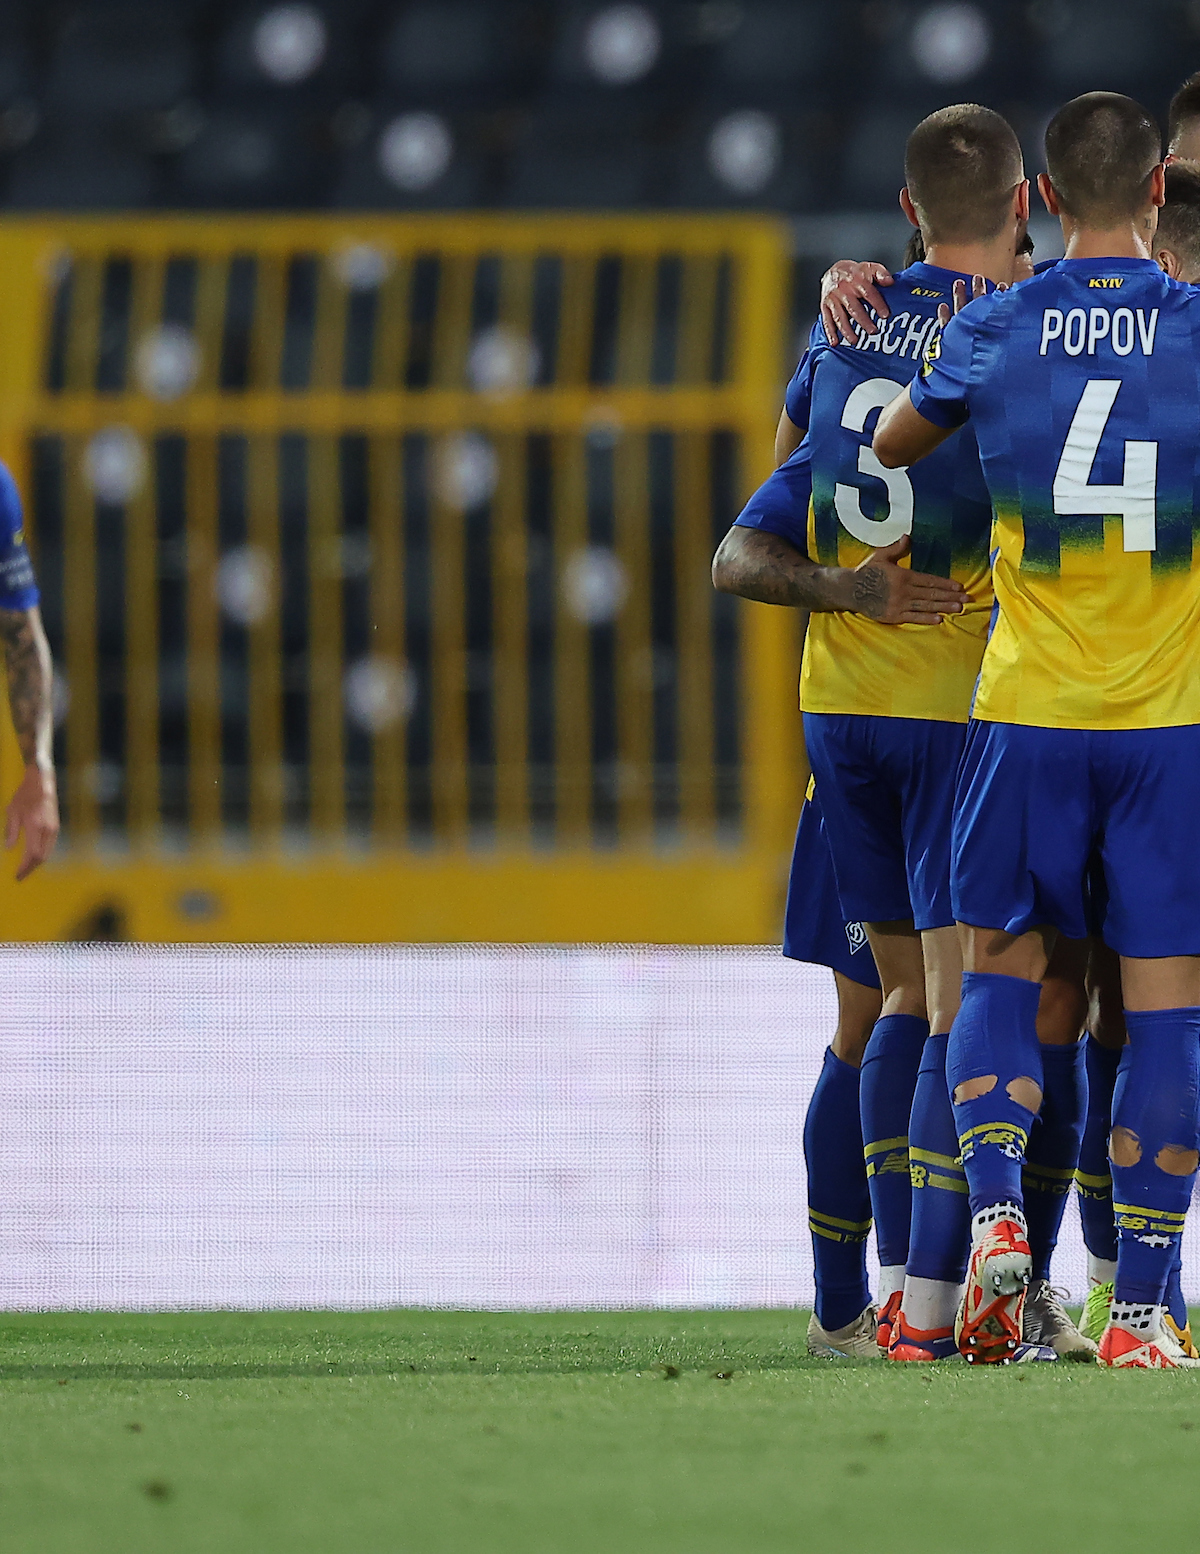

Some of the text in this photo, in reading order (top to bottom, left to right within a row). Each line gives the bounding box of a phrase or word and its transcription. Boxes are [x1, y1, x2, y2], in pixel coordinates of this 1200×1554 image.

[1038, 307, 1160, 357] POPOV
[1088, 278, 1124, 289] KYIV
[833, 377, 914, 548] 3
[1052, 379, 1158, 552] 4
